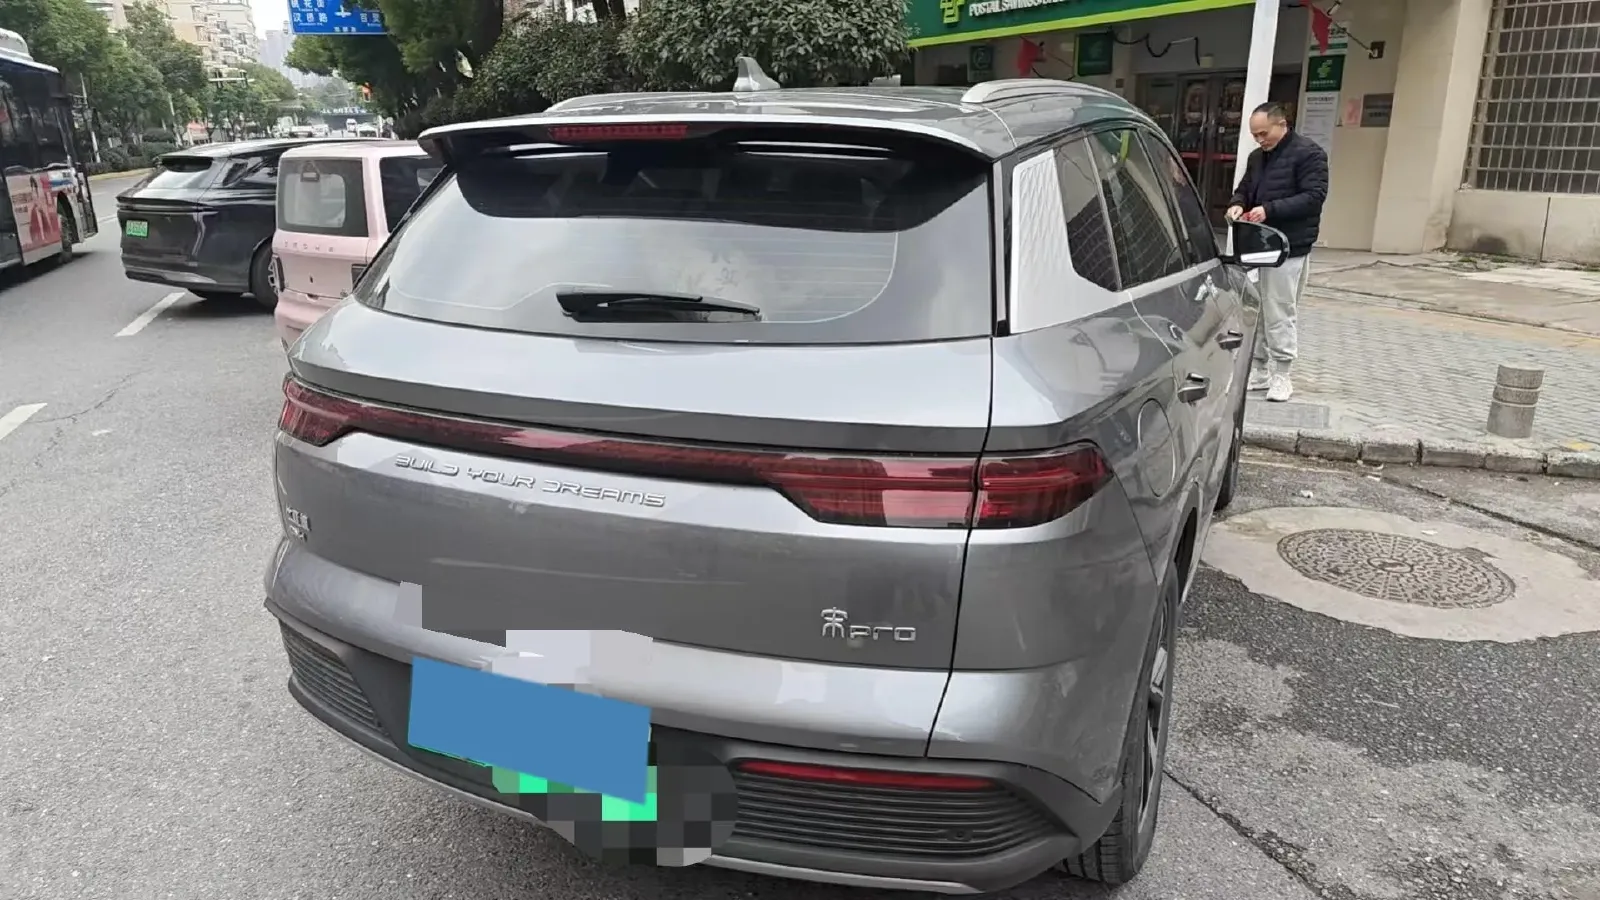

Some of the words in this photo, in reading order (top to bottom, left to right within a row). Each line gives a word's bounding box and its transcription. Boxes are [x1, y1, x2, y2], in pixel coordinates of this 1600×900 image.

[968, 0, 1001, 17] POSTAL
[395, 454, 459, 477] BUILD
[466, 466, 537, 490] YOUR
[541, 479, 667, 508] DREAMS
